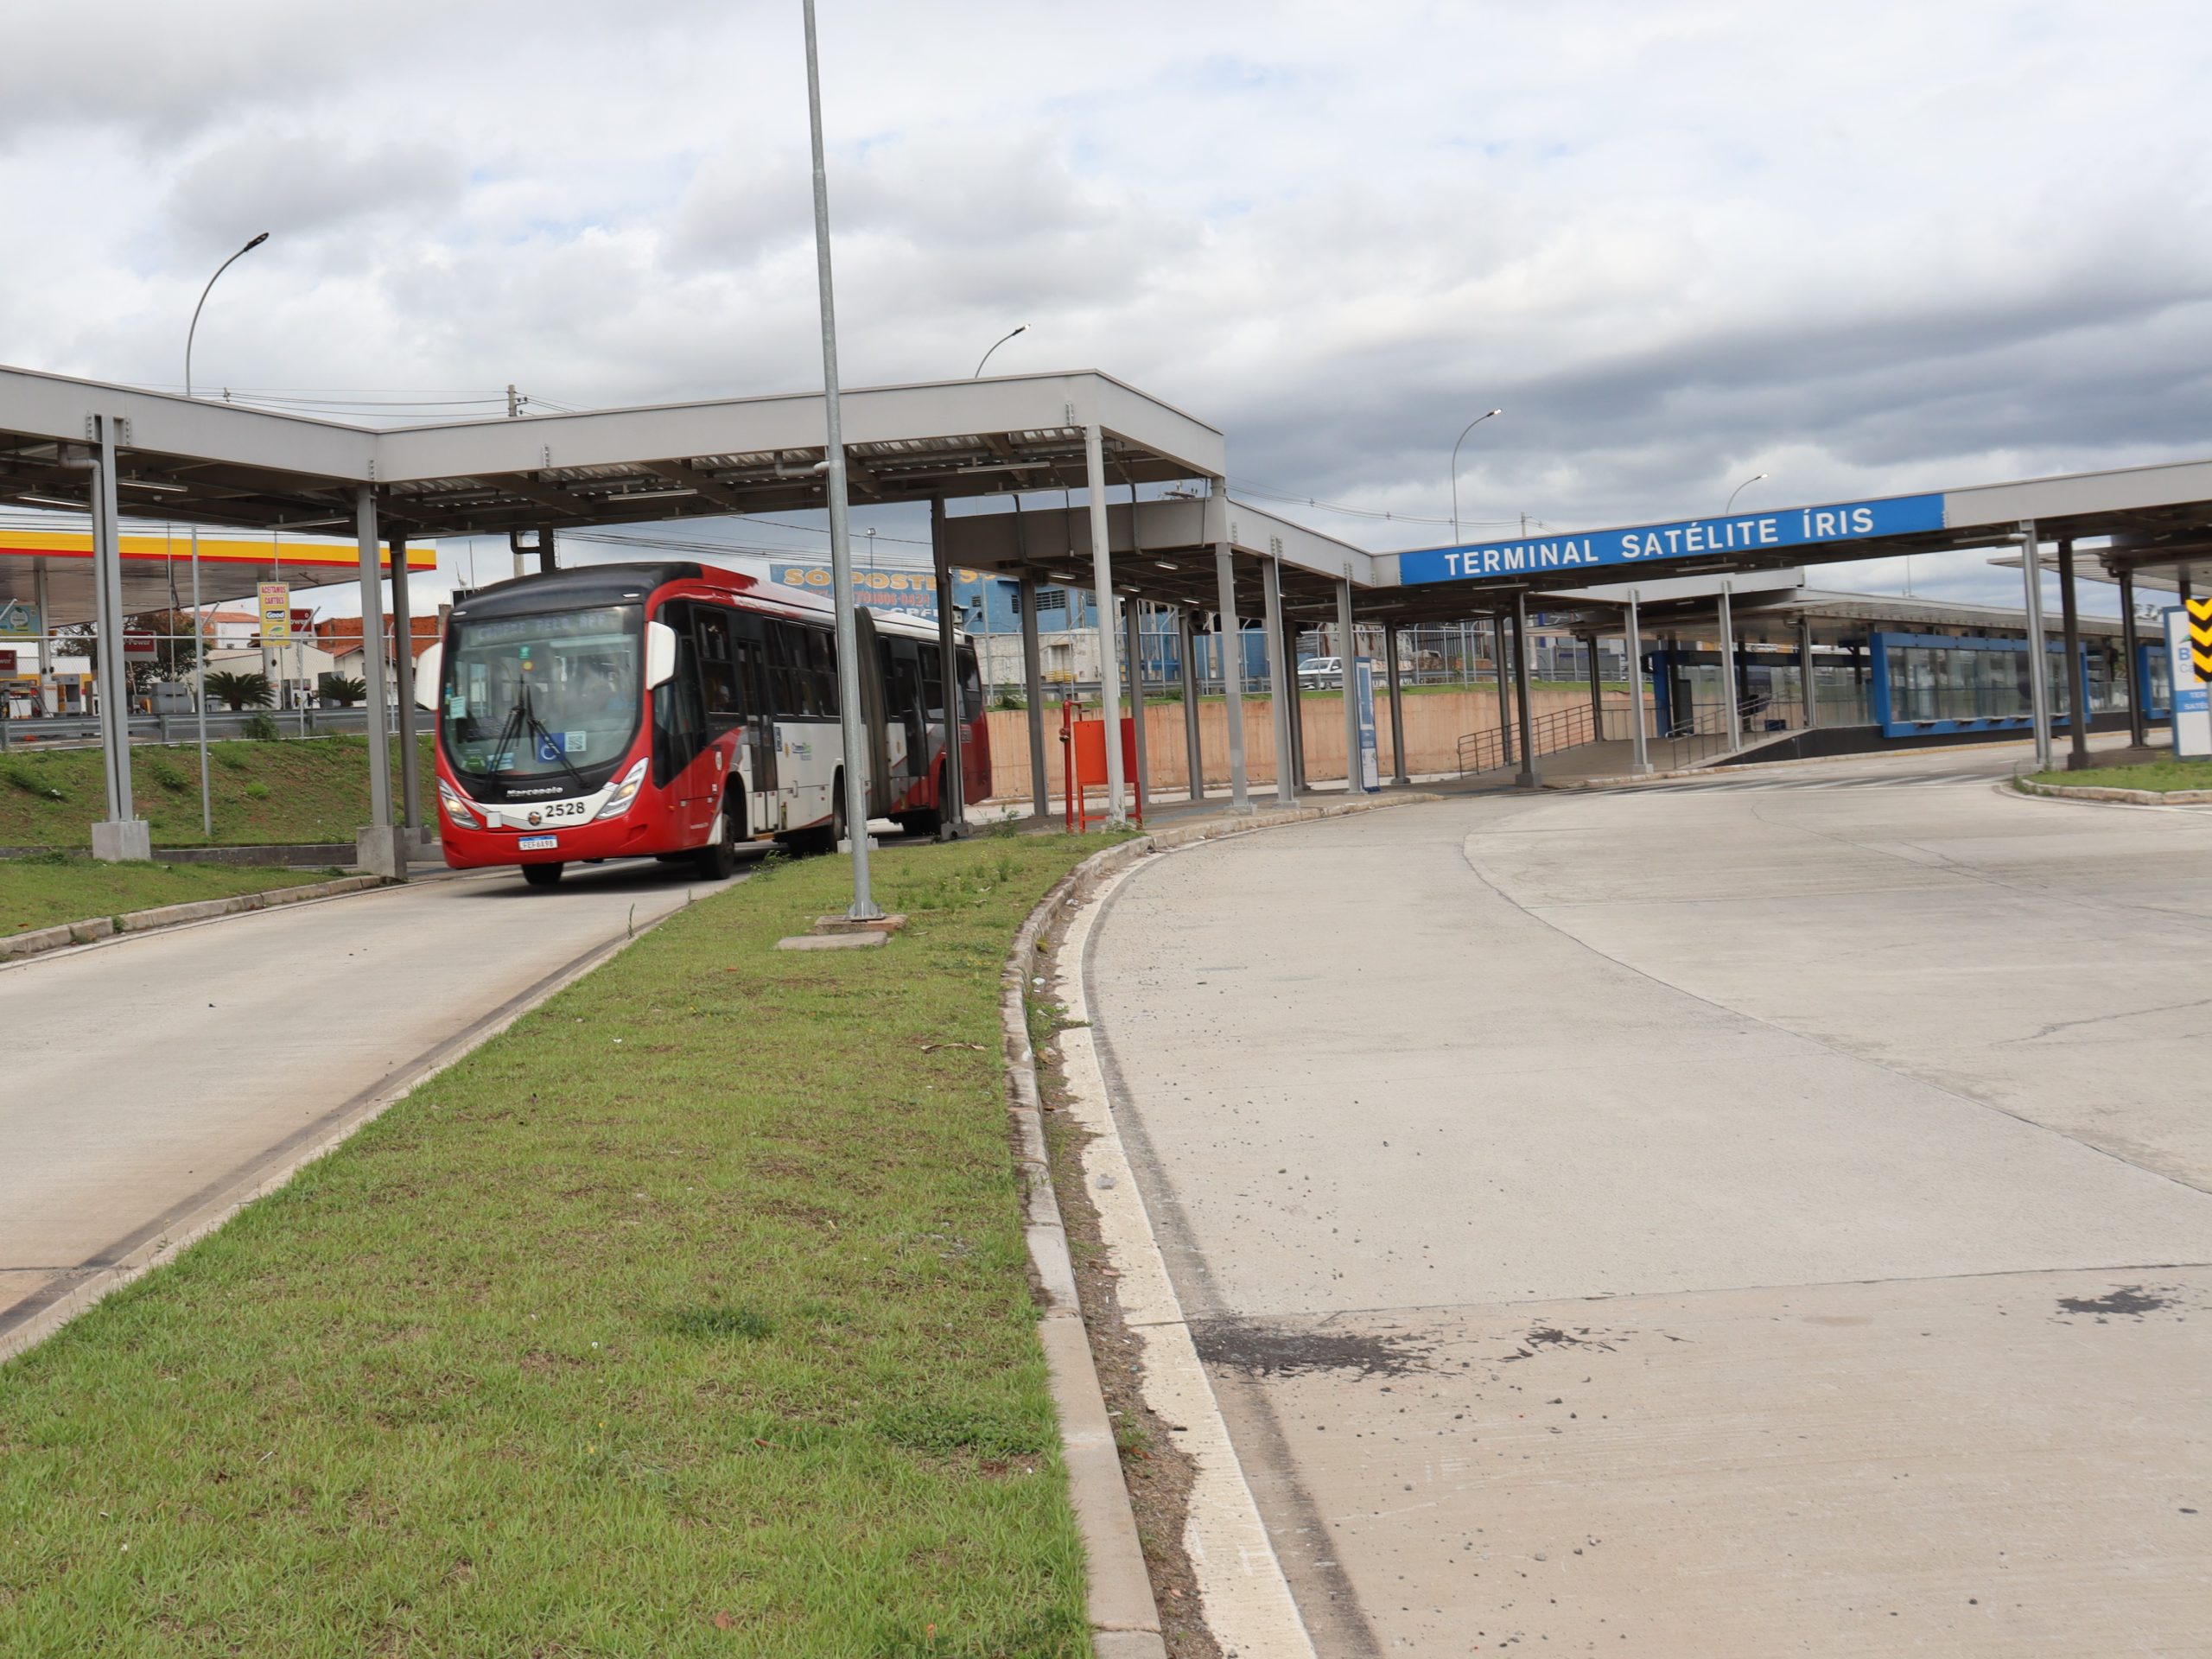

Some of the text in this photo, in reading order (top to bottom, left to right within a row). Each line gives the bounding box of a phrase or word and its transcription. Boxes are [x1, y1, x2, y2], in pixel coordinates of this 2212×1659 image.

[1445, 508, 1874, 577] TERMINAL SATÉLITE ÍRIS
[783, 567, 832, 587] SÓ
[506, 786, 563, 798] Marcopolo
[545, 802, 586, 818] 2528
